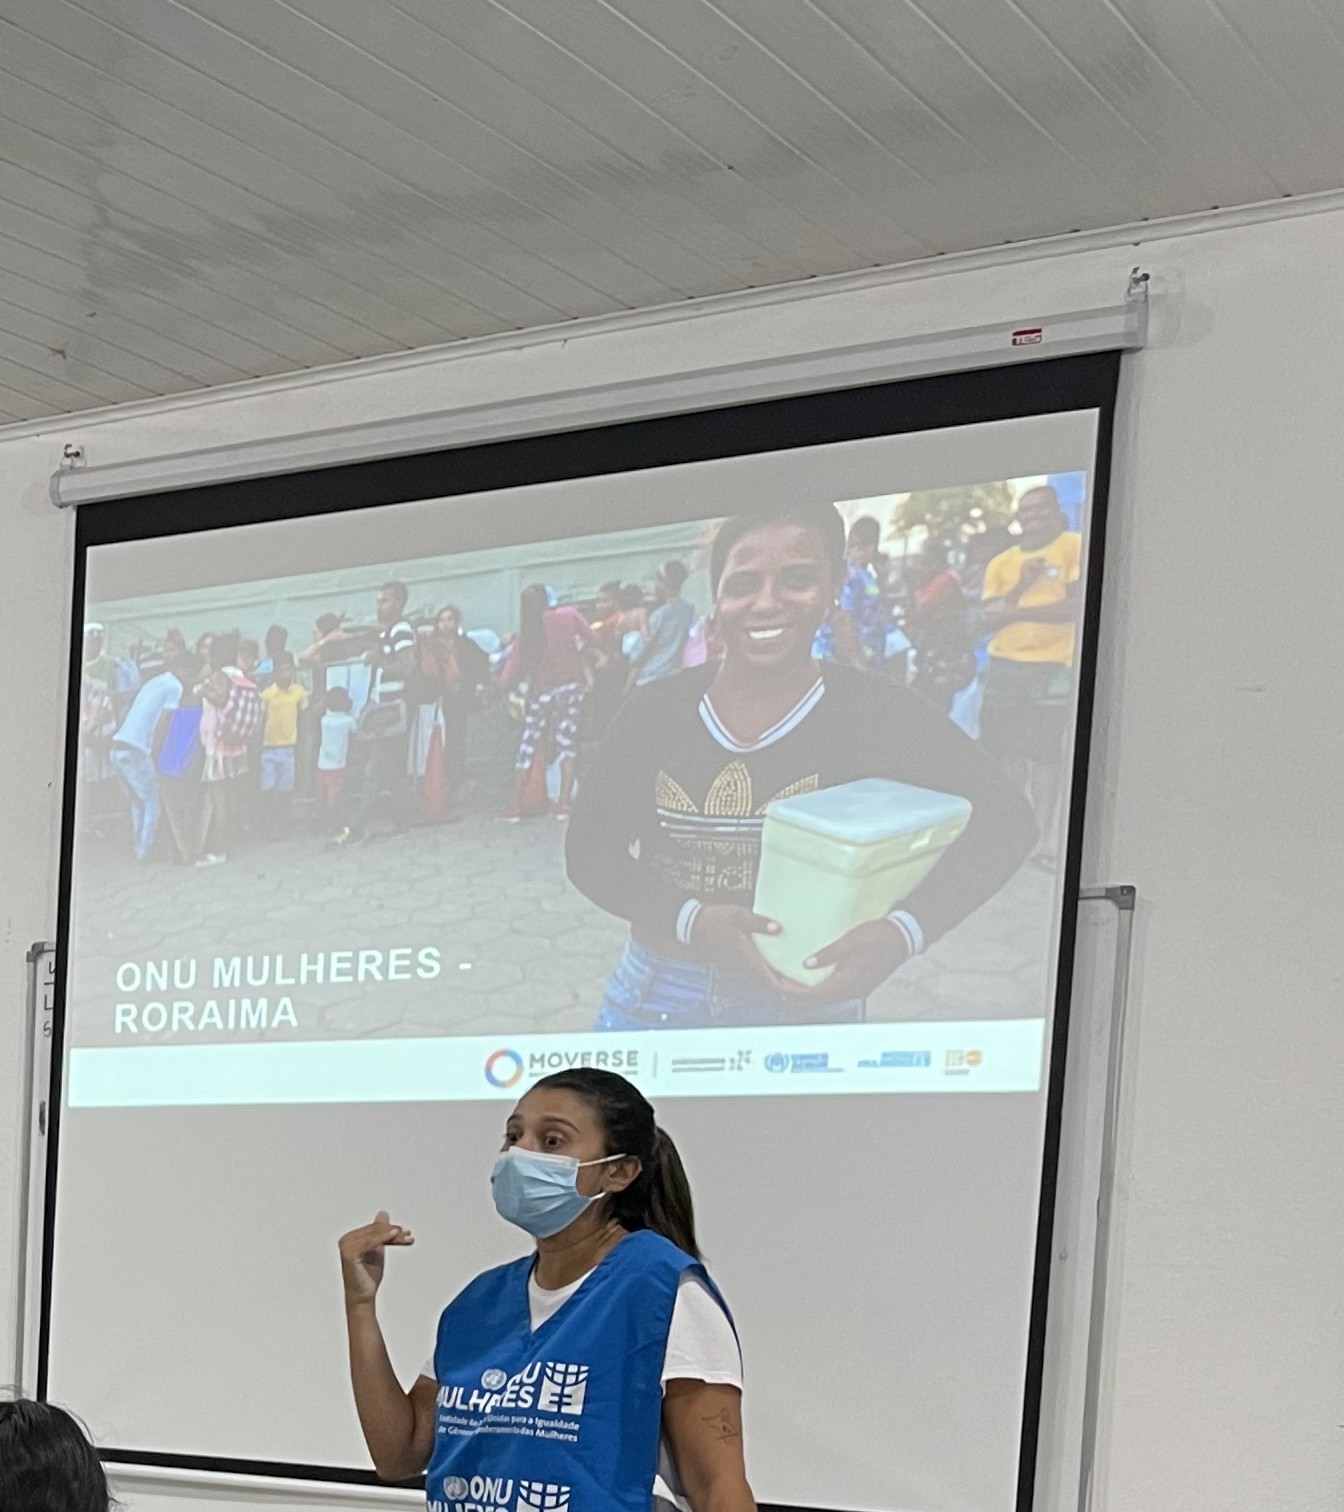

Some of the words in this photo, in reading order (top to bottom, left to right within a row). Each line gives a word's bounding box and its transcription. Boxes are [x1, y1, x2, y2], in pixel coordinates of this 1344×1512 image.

[115, 959, 198, 993] ONU
[212, 946, 442, 989] MULHERES
[114, 996, 299, 1034] RORAIMA
[528, 1049, 639, 1068] MOVERSE
[535, 1428, 579, 1443] Mulheres
[470, 1475, 514, 1505] ONU
